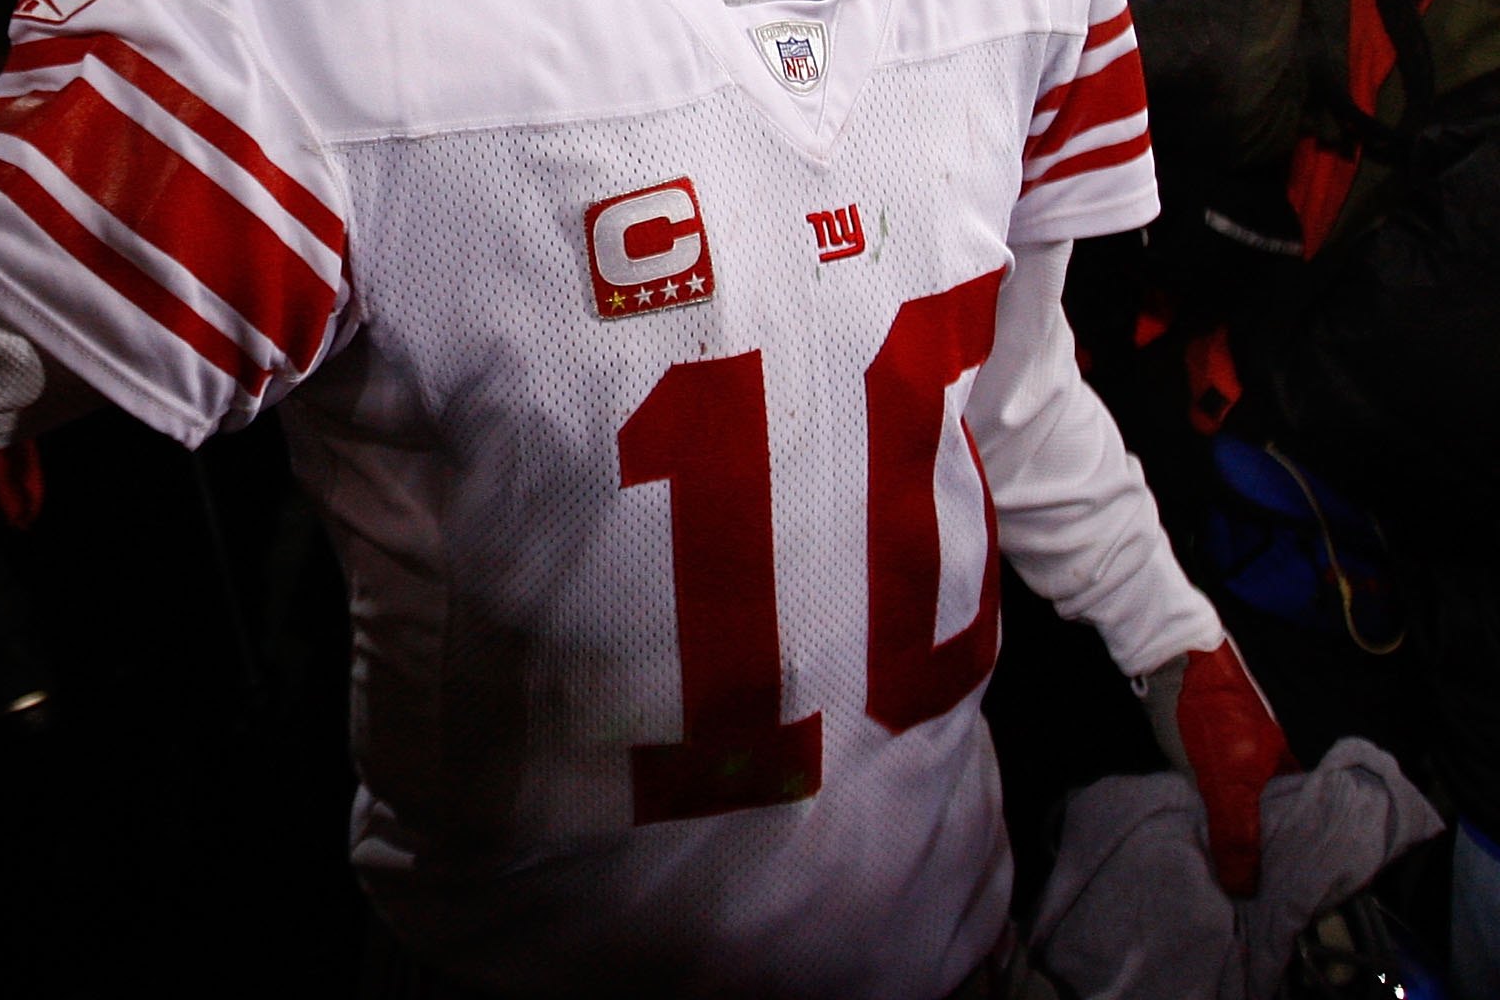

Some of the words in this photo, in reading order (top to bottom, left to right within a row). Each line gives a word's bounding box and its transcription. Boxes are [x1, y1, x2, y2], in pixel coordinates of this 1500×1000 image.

[784, 56, 817, 81] NFL
[594, 188, 702, 287] C
[617, 265, 1007, 827] 10
